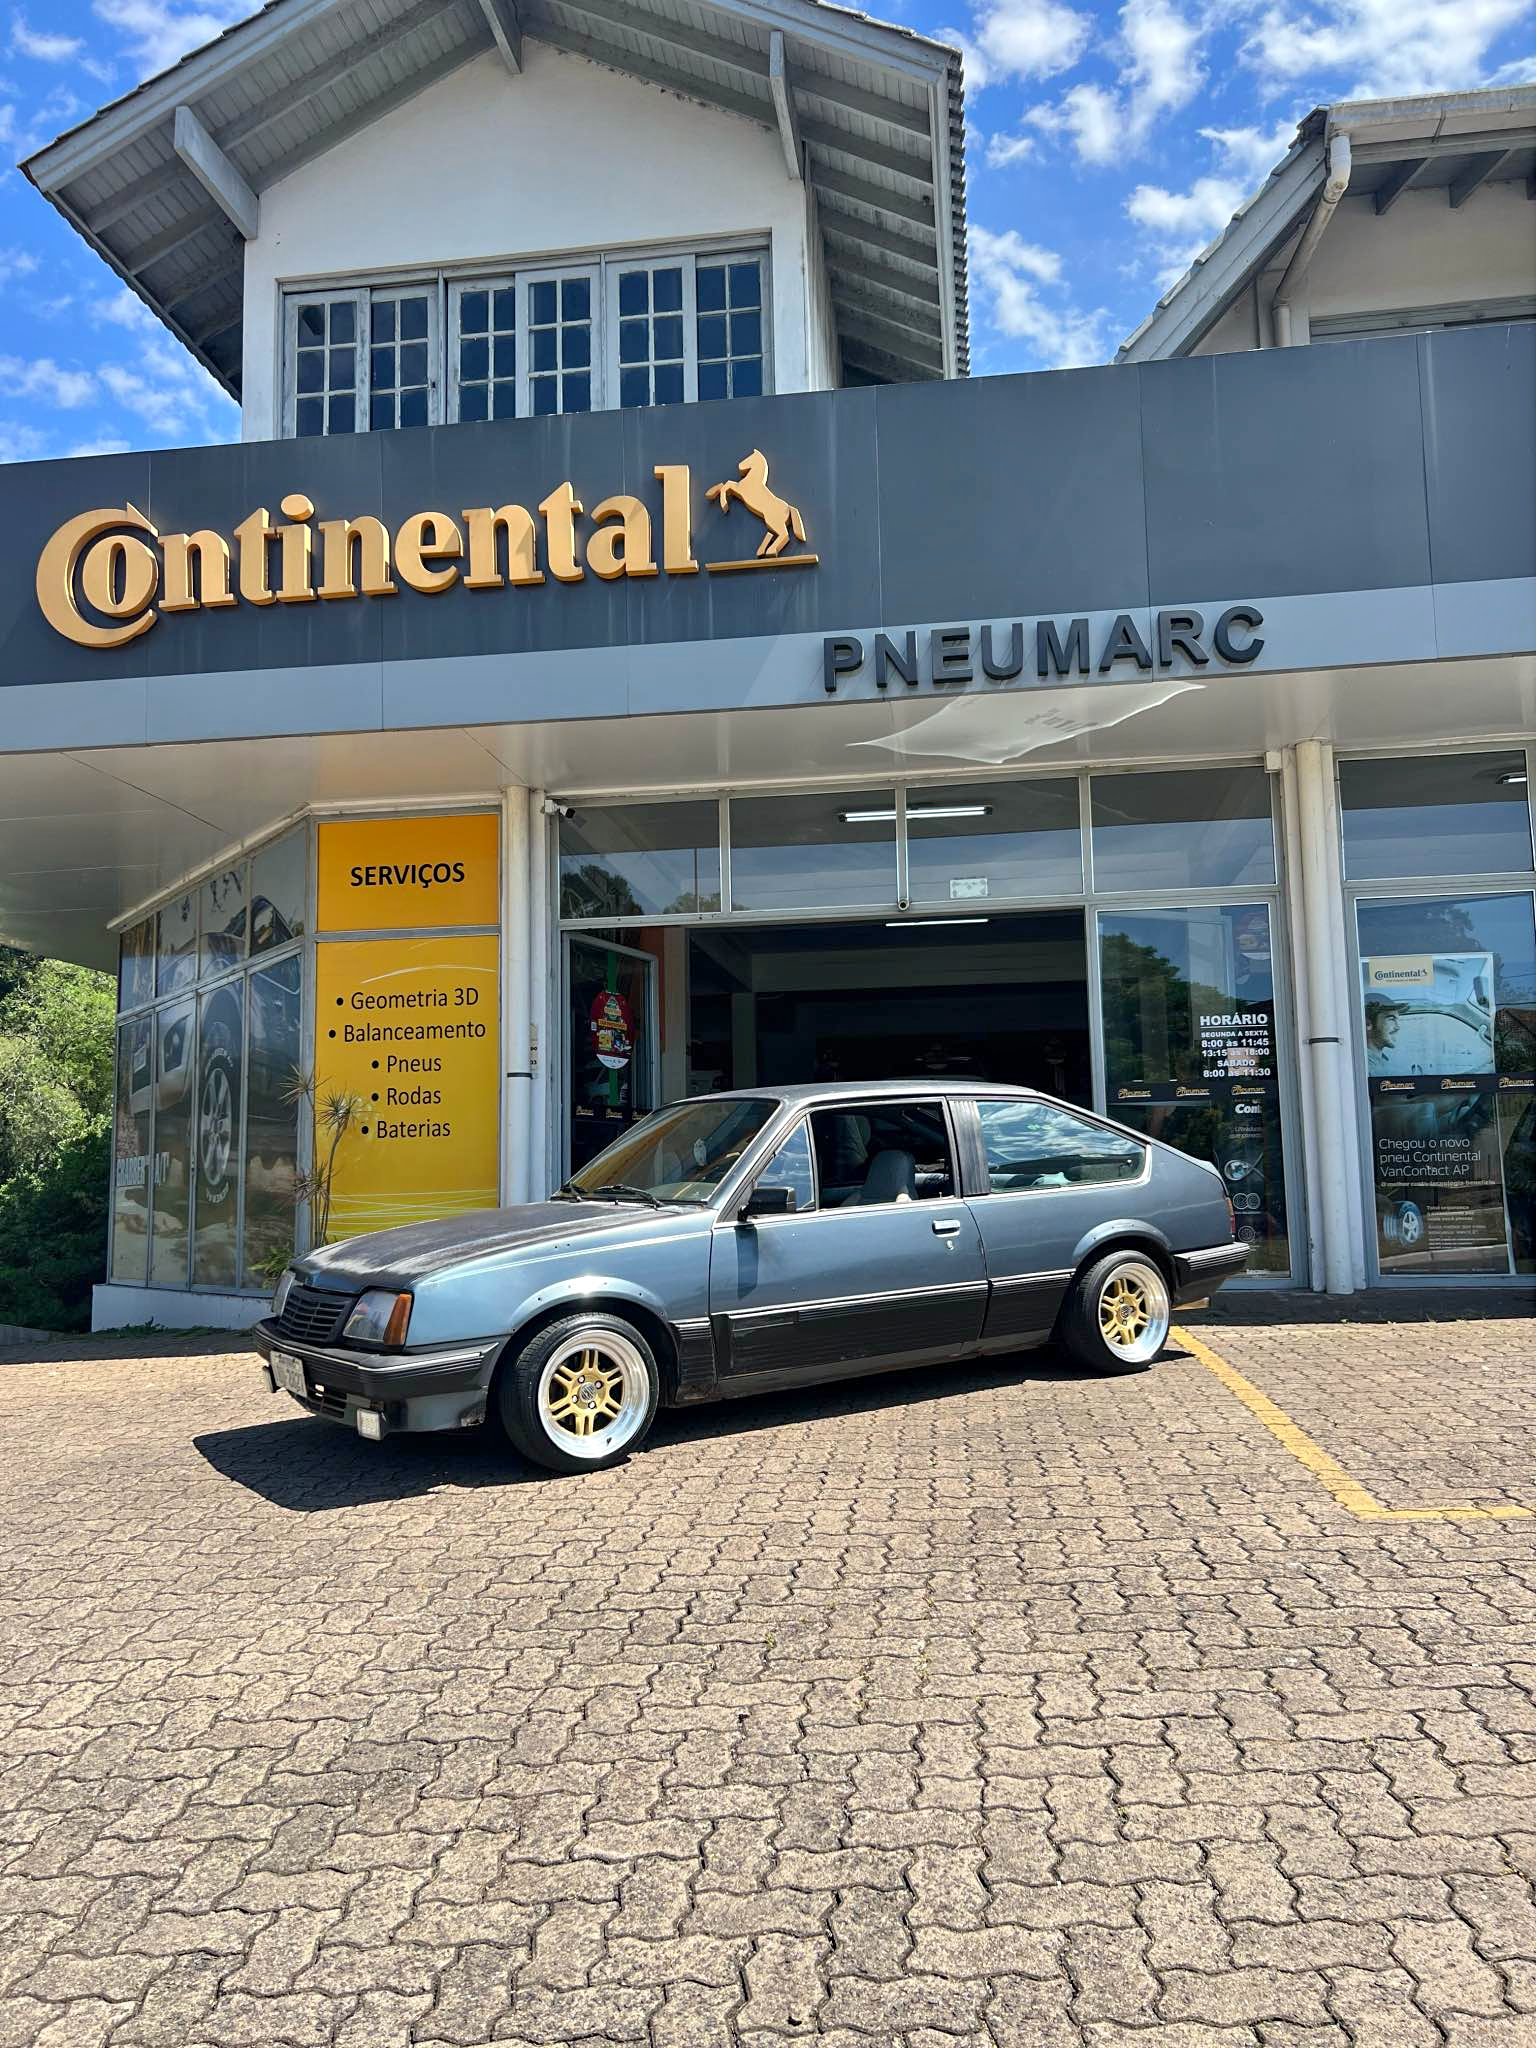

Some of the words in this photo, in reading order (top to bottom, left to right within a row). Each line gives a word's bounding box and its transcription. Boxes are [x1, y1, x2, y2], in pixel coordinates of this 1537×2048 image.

[35, 463, 699, 649] Continental
[823, 605, 1265, 693] PNEUMARC
[350, 862, 465, 888] SERVIÇOS
[1374, 969, 1421, 980] Continental
[351, 988, 448, 1010] Geometria
[454, 987, 479, 1006] 3D
[1200, 1012, 1268, 1026] HORÁRIO
[344, 1021, 486, 1042] Balanceamento
[1201, 1039, 1223, 1048] 8:00
[1241, 1038, 1269, 1047] 11:45
[1201, 1049, 1228, 1057] 13:15
[1244, 1047, 1270, 1056] 18:00
[387, 1055, 442, 1073] Pneus
[1203, 1069, 1225, 1078] 8:00
[1243, 1068, 1271, 1077] 11:30
[387, 1085, 442, 1105] Rodas
[377, 1119, 451, 1138] Baterias
[1378, 1138, 1425, 1150] Chegou
[1428, 1139, 1437, 1148] o
[1440, 1138, 1470, 1148] novo
[1379, 1154, 1410, 1164] pneu
[1413, 1150, 1481, 1163] Continental
[1380, 1165, 1449, 1177] VanContact
[1452, 1164, 1470, 1176] AP
